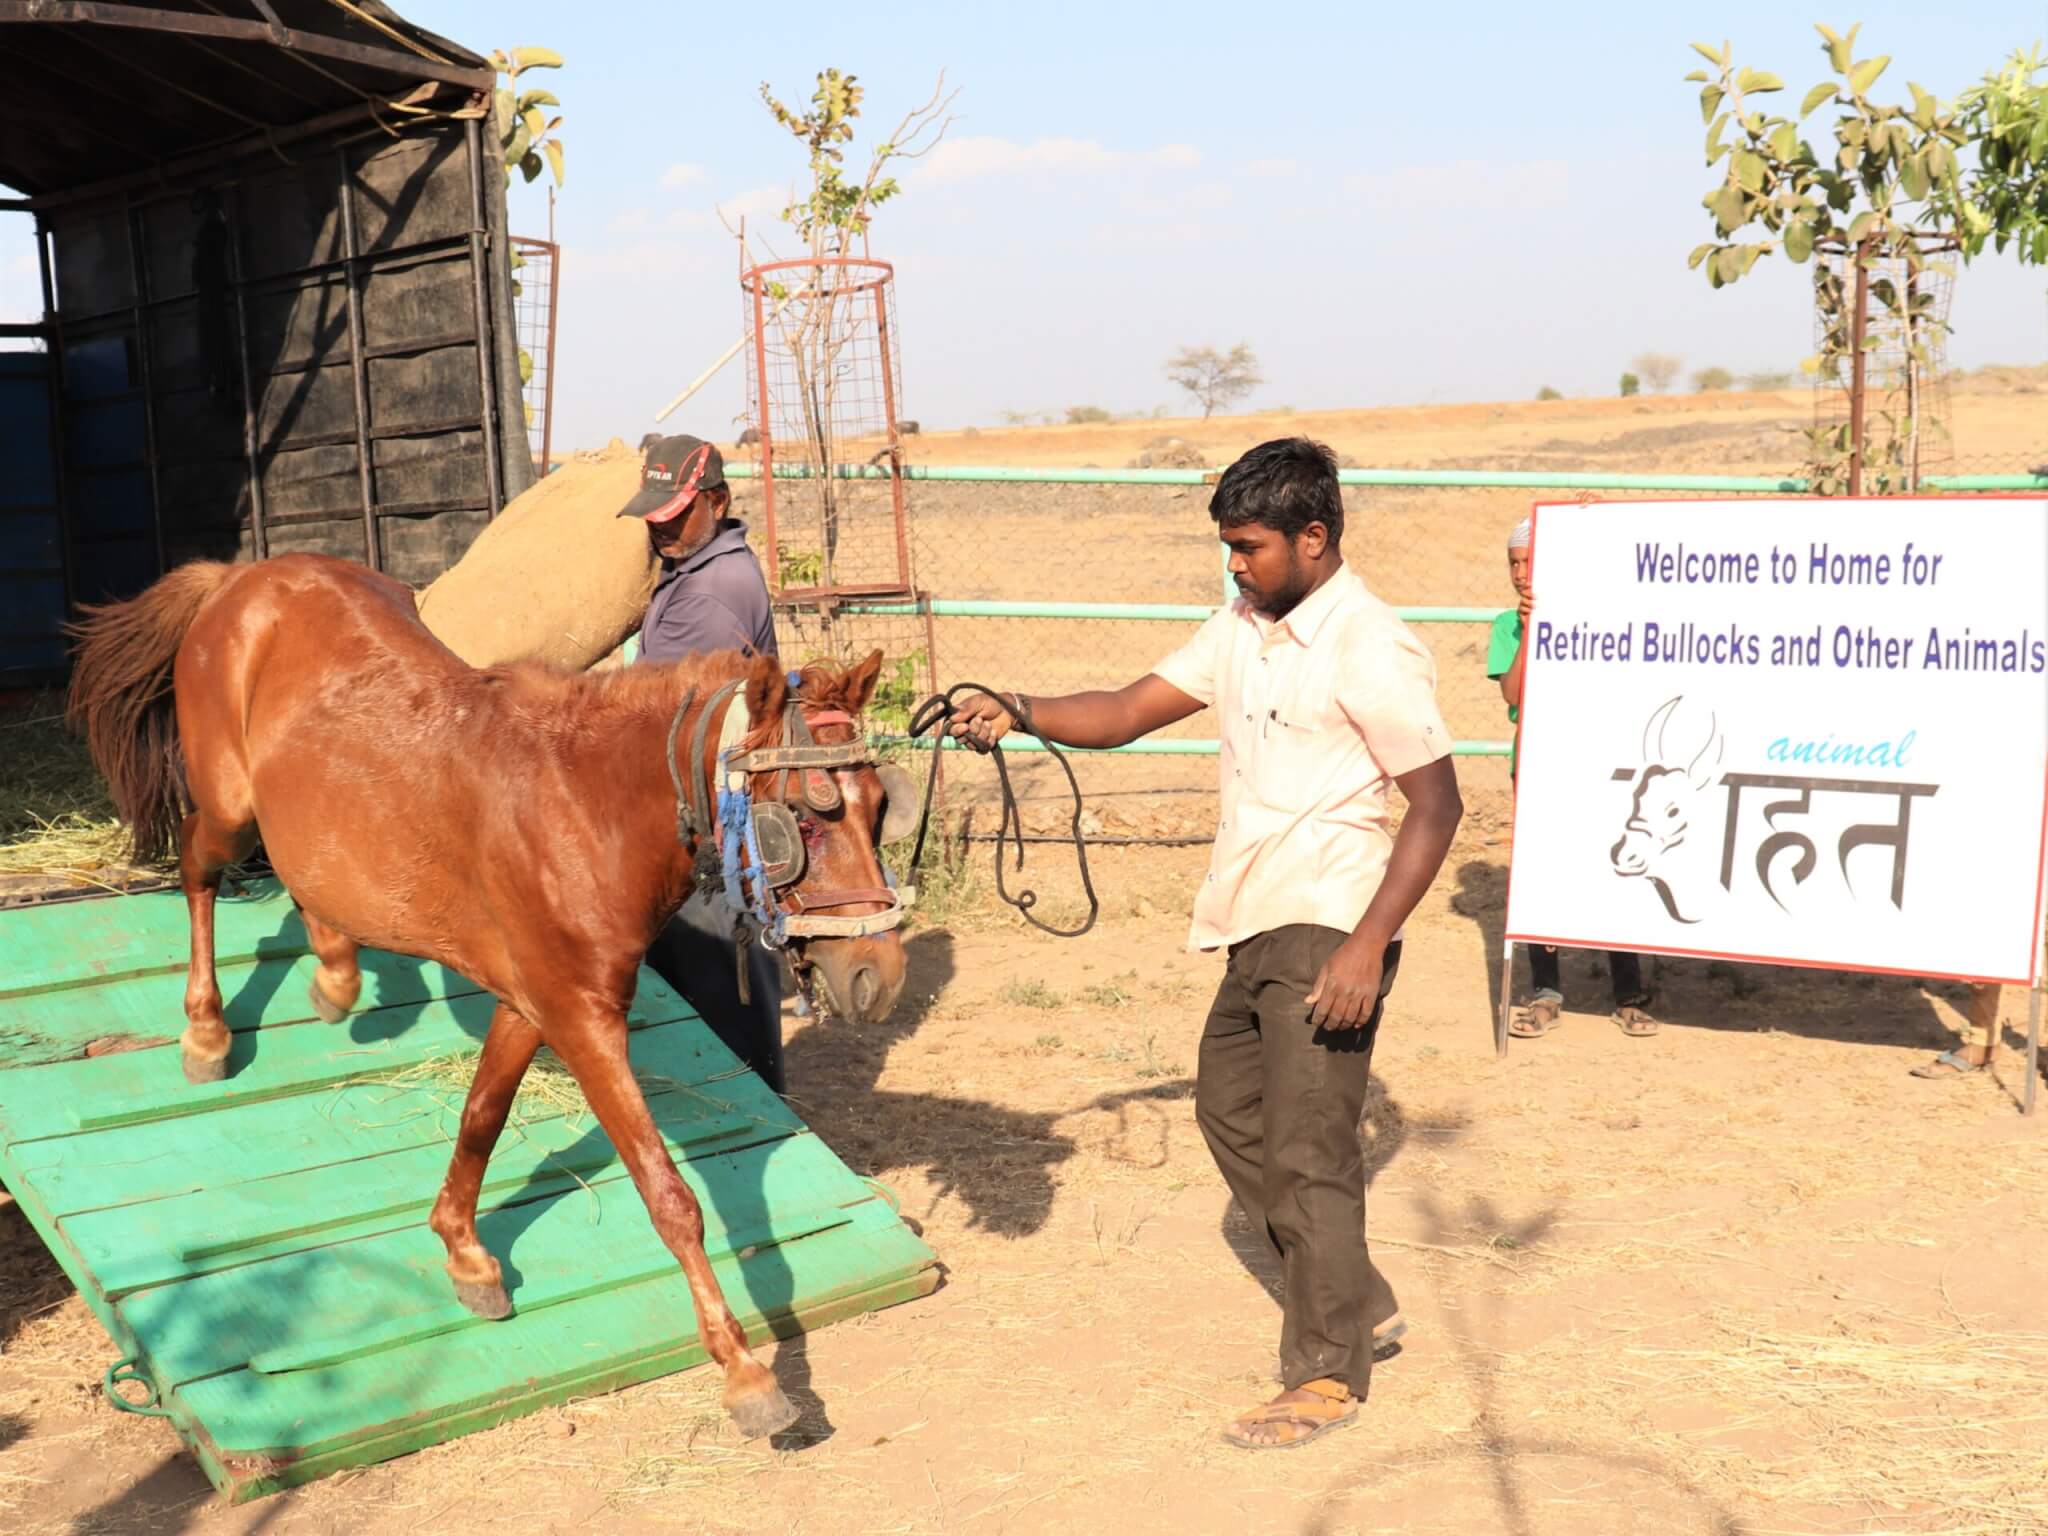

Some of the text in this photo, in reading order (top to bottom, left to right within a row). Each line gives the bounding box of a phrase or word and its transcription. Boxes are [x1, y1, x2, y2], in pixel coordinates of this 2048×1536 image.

[1636, 543, 1942, 585] Welcome to Home for
[1536, 622, 2045, 673] Retired Bullocks and Other Animals
[1767, 730, 1917, 767] animal
